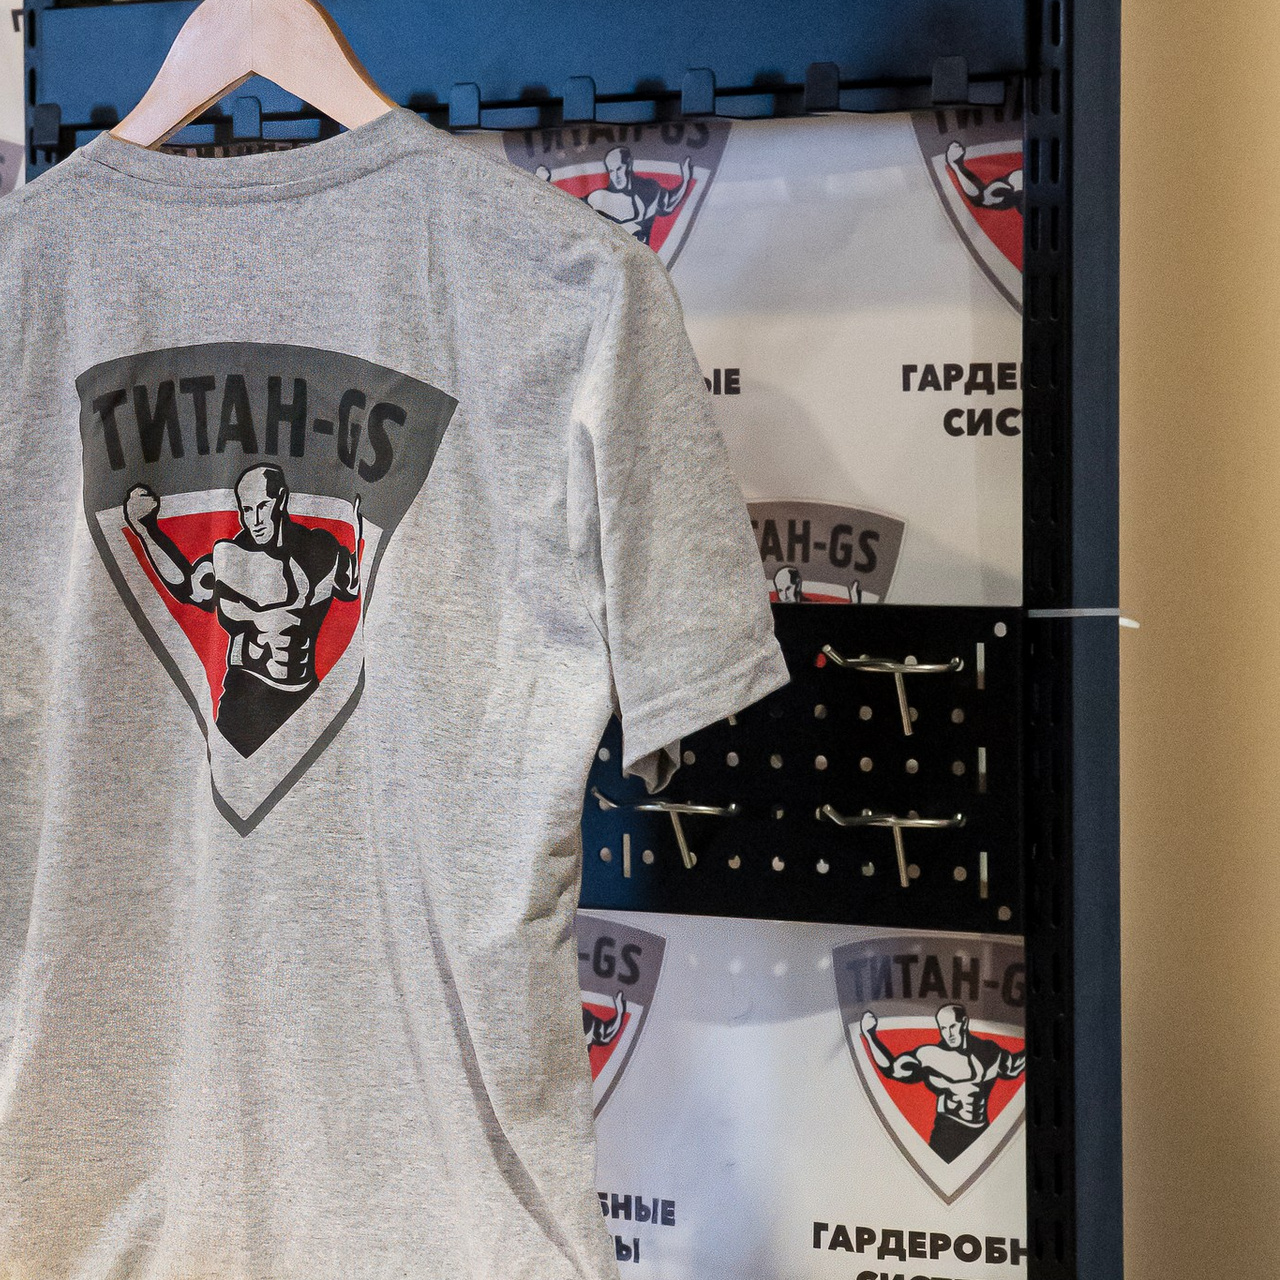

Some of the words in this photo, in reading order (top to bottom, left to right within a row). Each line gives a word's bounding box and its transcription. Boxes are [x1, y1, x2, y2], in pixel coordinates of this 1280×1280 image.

[902, 362, 1023, 396] ГАРДЕ
[93, 374, 407, 483] ТИТАН-GS
[943, 408, 1023, 437] СИС
[751, 519, 880, 574] АН-GS
